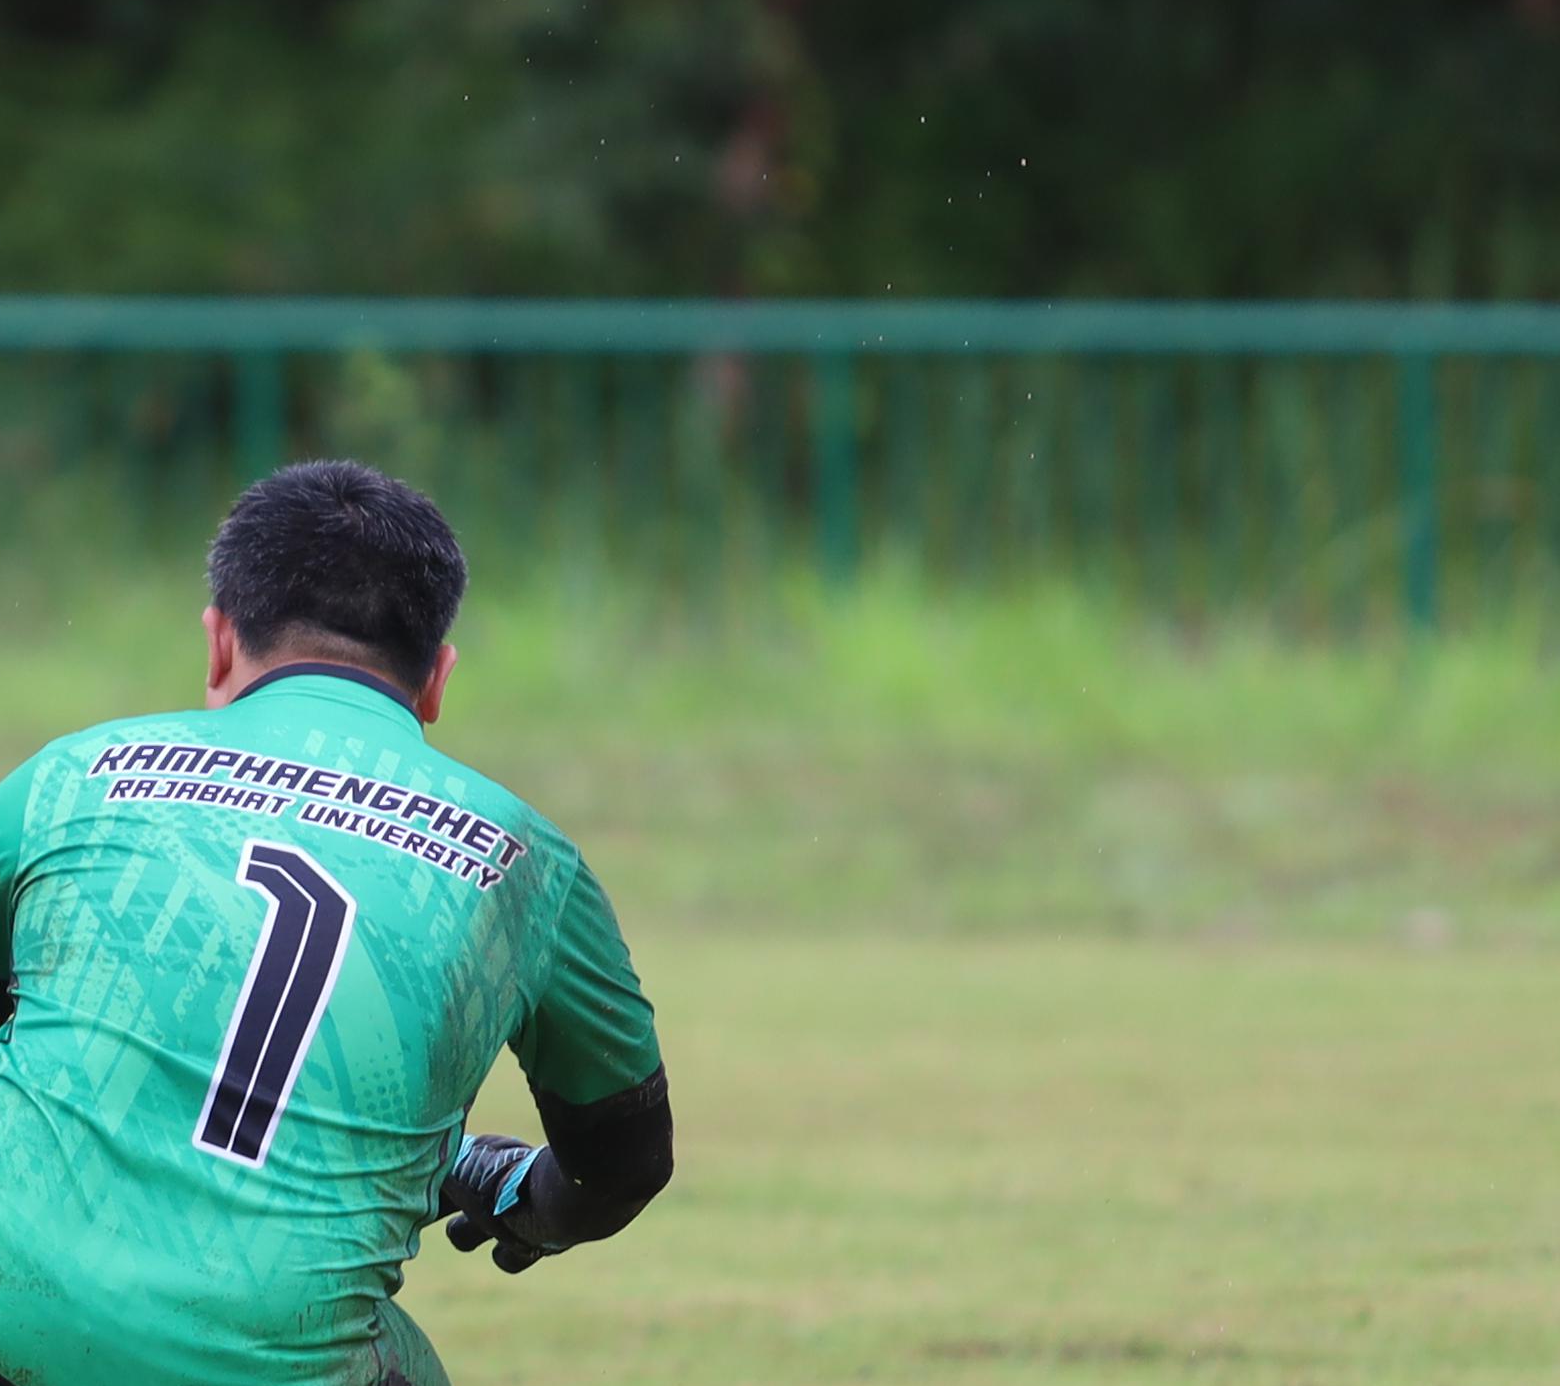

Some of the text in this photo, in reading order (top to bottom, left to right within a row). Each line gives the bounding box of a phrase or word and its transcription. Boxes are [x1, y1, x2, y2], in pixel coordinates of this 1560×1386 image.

[89, 743, 526, 868] KAMPHAENGPHET
[107, 777, 502, 890] RAJABHAT UNIVERSITY
[195, 841, 354, 1165] 1
